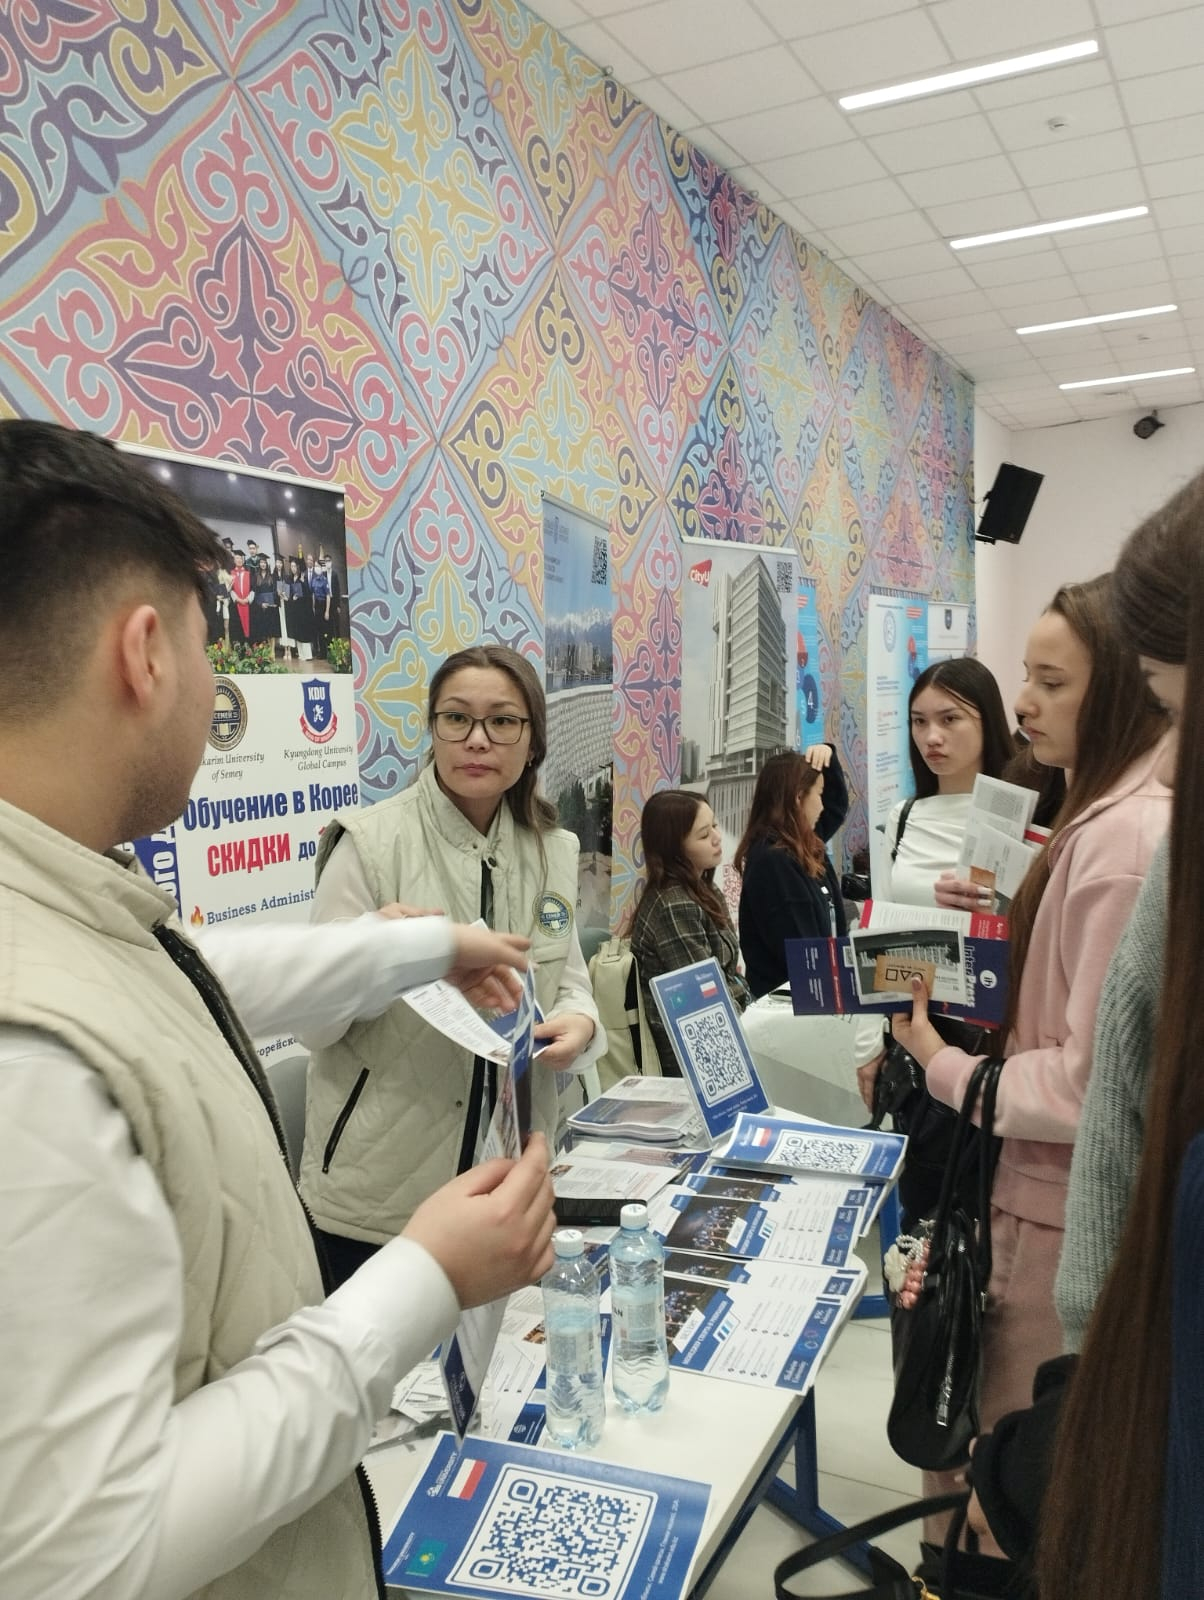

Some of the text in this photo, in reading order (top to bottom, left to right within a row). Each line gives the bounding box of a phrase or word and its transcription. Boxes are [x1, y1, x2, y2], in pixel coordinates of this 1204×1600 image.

[689, 568, 711, 586] CityU
[308, 686, 326, 701] KDU
[225, 752, 265, 764] University
[283, 745, 353, 760] Kyungdong University
[297, 759, 347, 771] Global Campus
[211, 769, 244, 783] of Semey
[183, 783, 359, 831] Обучение в Корее
[207, 832, 317, 877] СКИДКИ до
[206, 888, 316, 925] Business Administ
